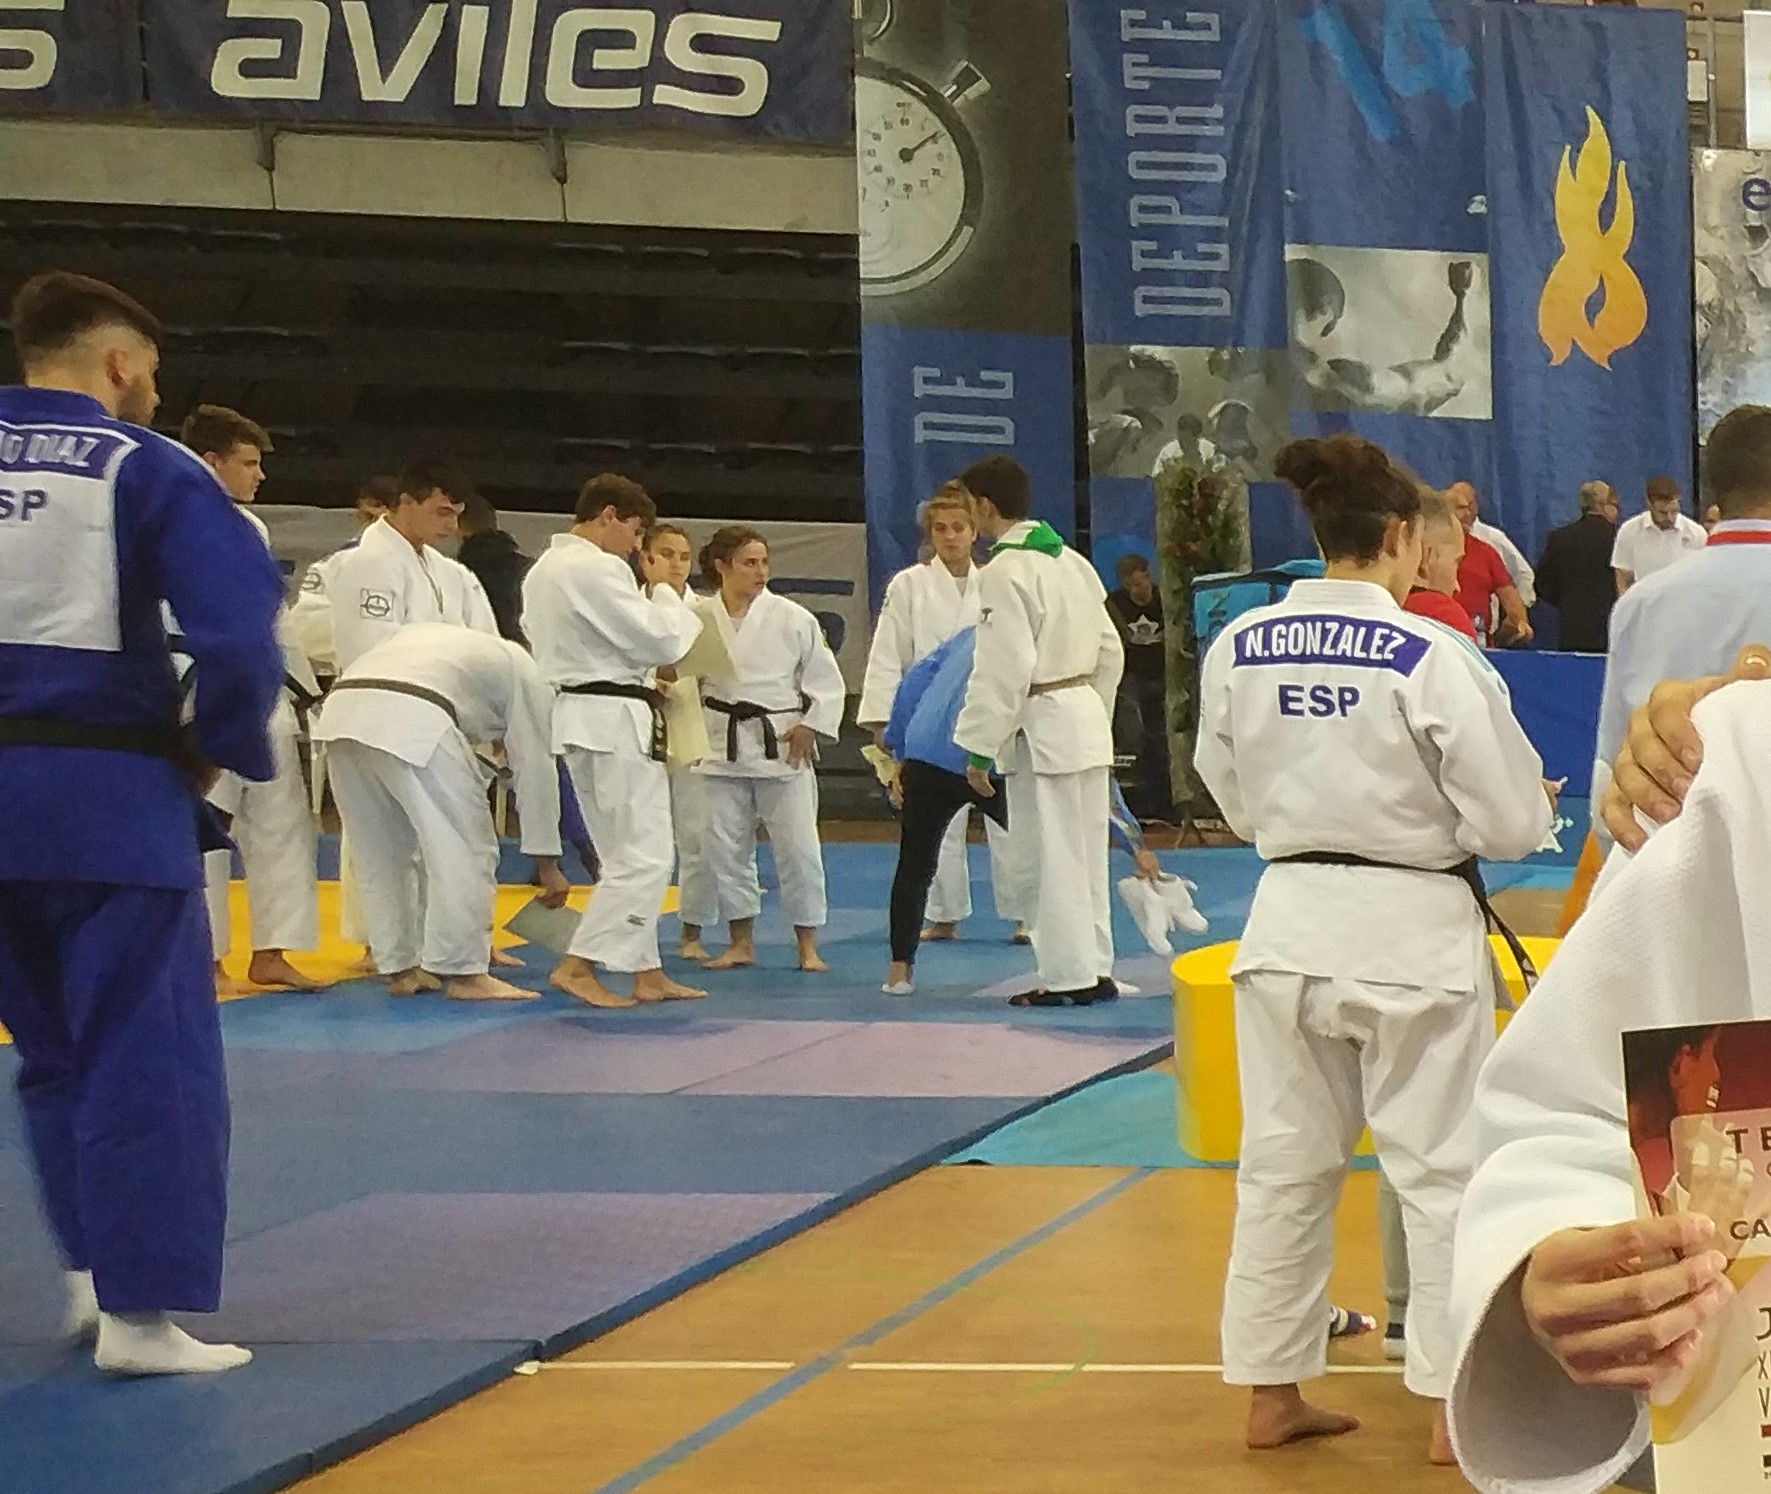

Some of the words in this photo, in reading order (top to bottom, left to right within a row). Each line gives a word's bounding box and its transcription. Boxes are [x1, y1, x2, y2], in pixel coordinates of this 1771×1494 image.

[1120, 9, 1232, 318] DEPORTE
[1244, 620, 1407, 661] N.GONZALEZ
[1278, 683, 1362, 719] ESP
